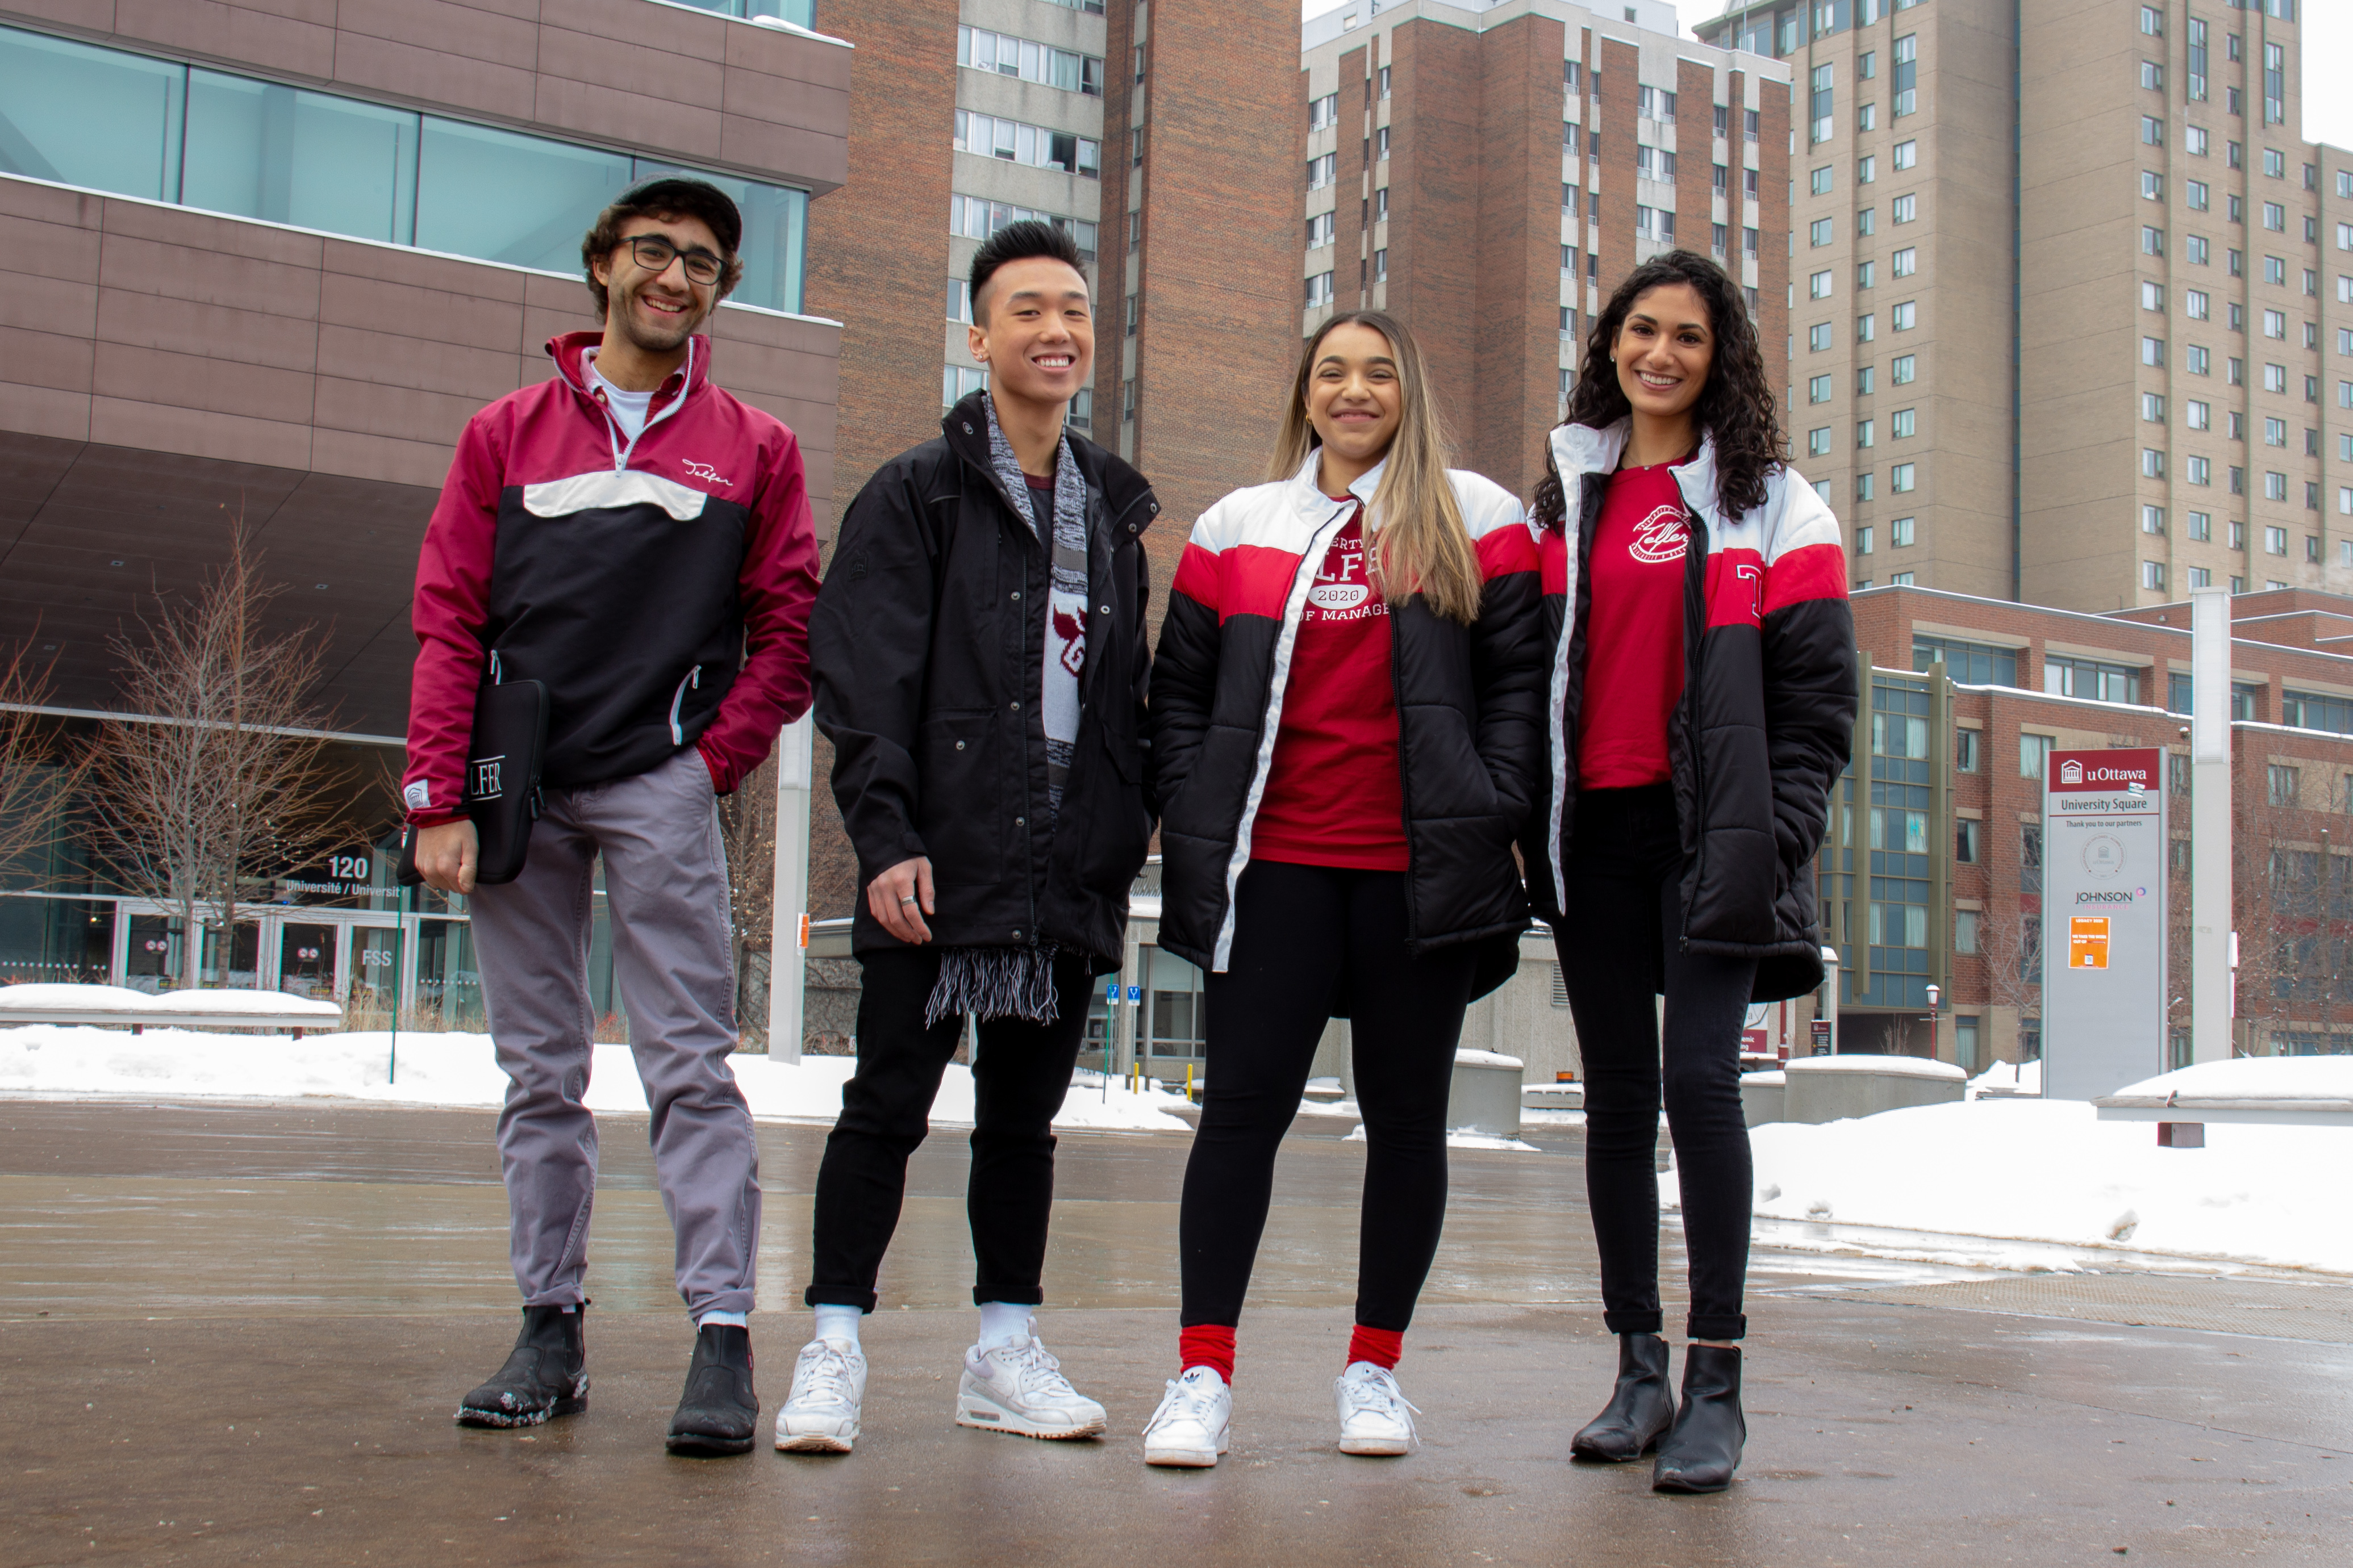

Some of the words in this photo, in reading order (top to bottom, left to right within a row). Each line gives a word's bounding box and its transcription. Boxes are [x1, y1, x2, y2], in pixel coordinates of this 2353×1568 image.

[682, 458, 733, 486] Telfer
[1317, 589, 1359, 601] 2020
[2061, 798, 2110, 812] University
[2112, 797, 2147, 812] Square
[2116, 819, 2142, 828] partners
[329, 855, 368, 879] 120
[286, 880, 341, 894] Université
[2075, 892, 2133, 904] JOHNSON
[362, 950, 393, 967] FSS
